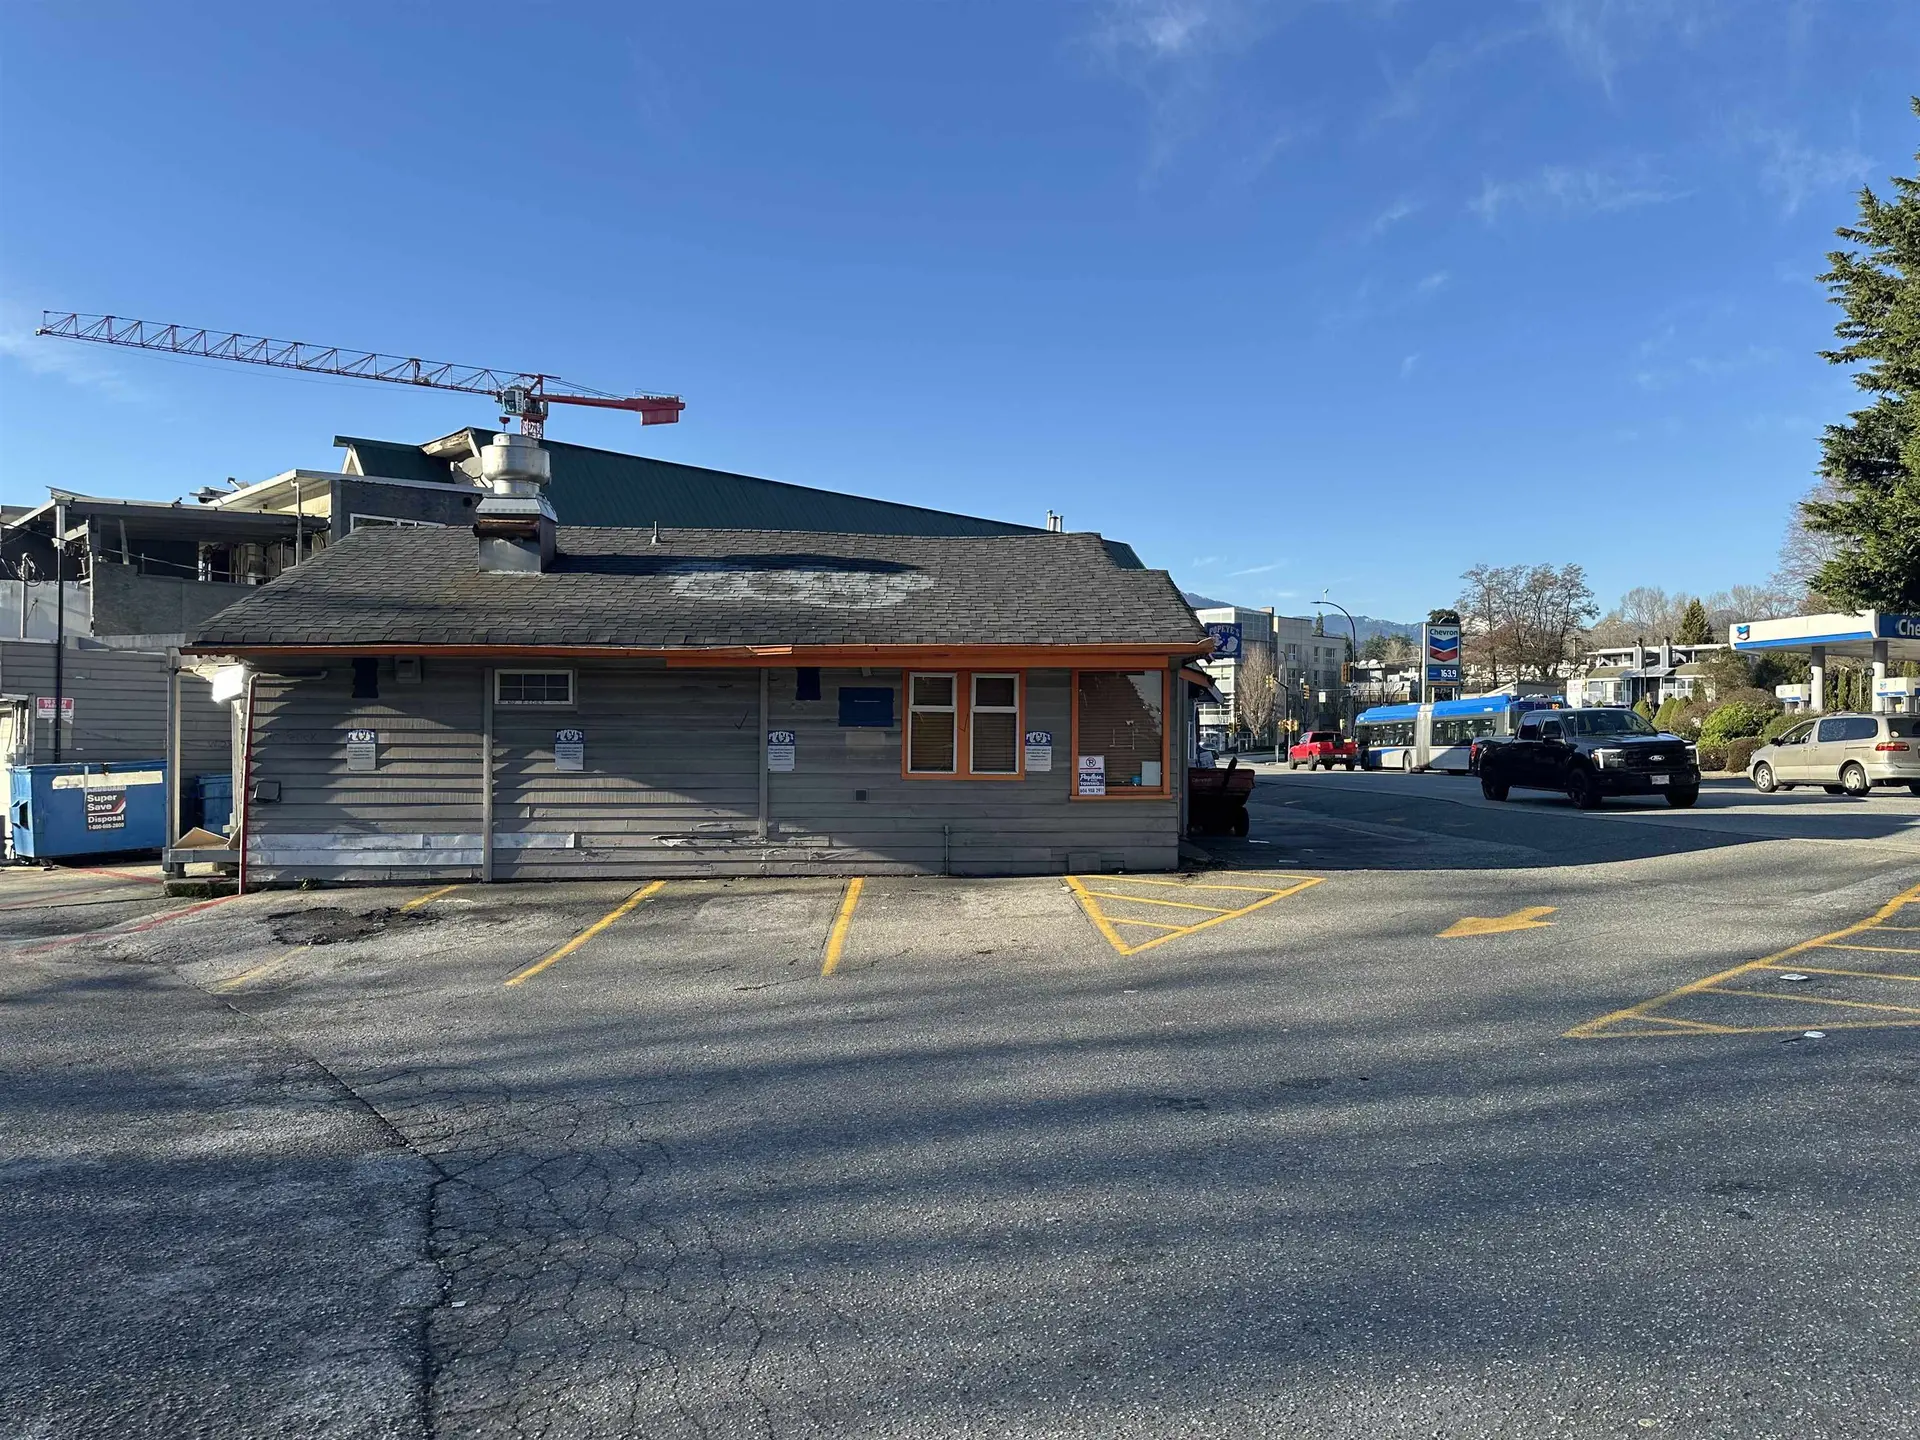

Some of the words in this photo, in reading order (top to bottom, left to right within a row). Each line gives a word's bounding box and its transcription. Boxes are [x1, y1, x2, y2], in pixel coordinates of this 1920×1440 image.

[1429, 628, 1458, 636] Chevron
[1440, 669, 1457, 678] 163.9
[87, 794, 117, 803] Super
[88, 814, 124, 824] Disposal
